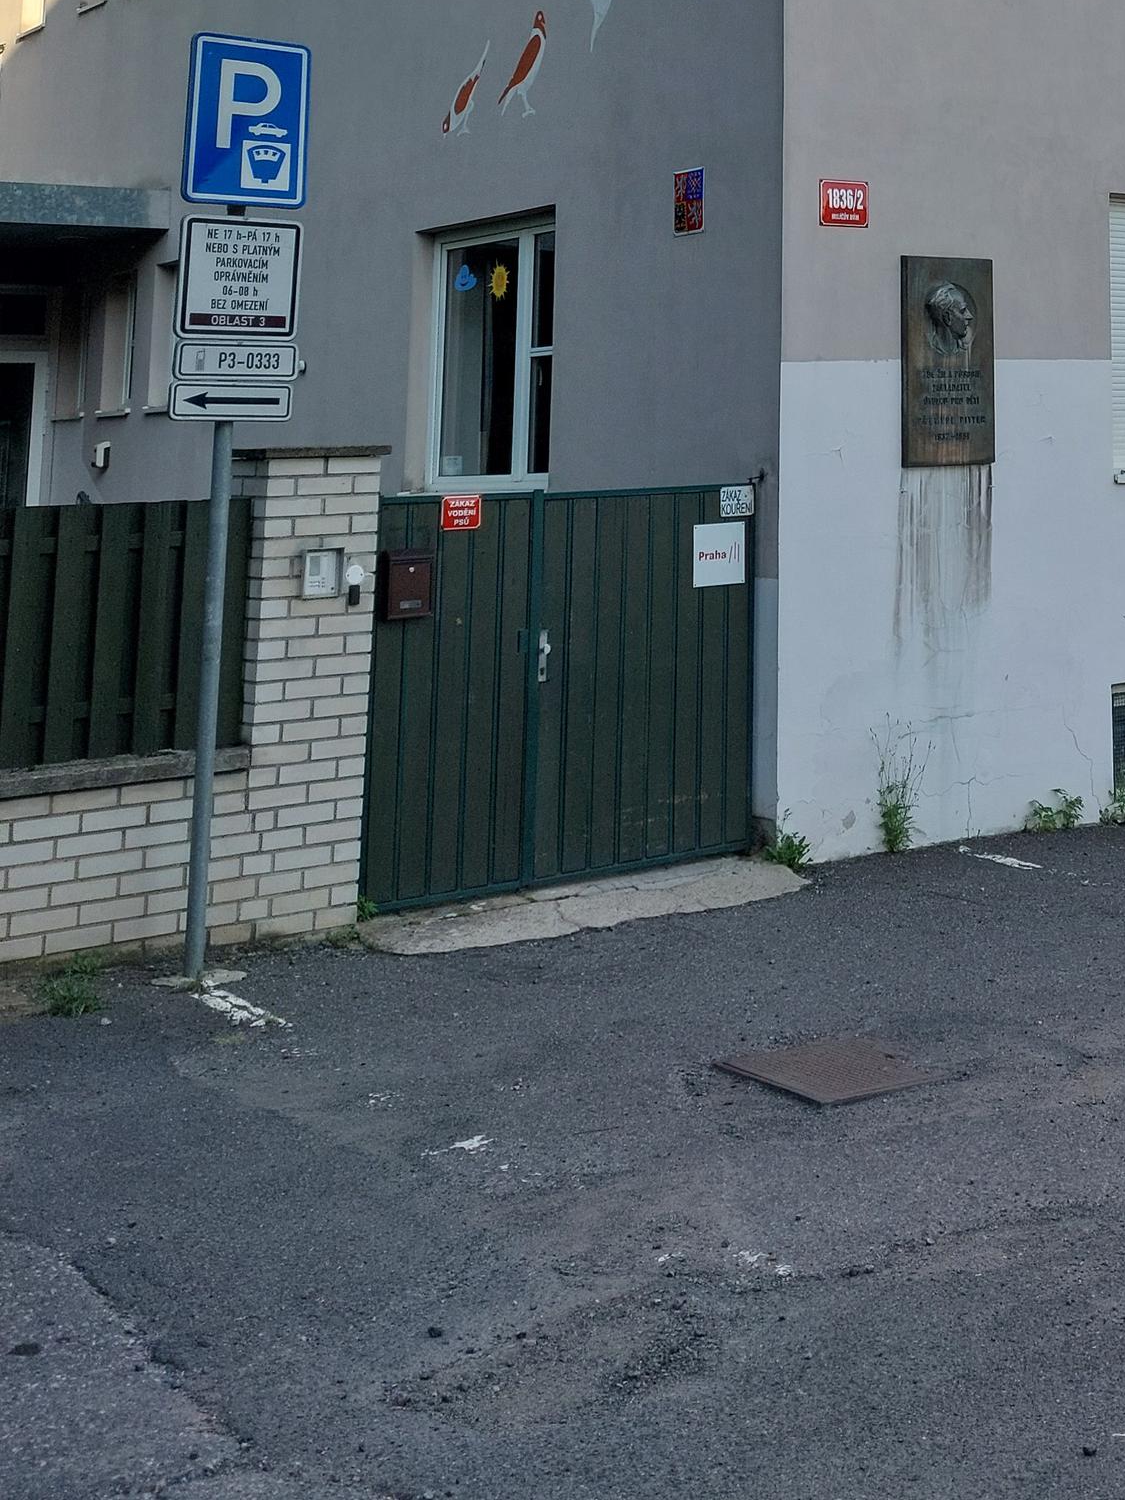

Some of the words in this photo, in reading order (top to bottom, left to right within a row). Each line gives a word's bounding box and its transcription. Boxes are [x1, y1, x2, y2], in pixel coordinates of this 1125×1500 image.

[215, 58, 282, 149] P
[827, 188, 864, 212] 1836/2
[207, 228, 219, 240] NE
[224, 229, 233, 240] 17
[262, 232, 271, 242] 17
[274, 233, 280, 243] h
[205, 242, 229, 253] NEBO
[232, 243, 239, 254] S
[242, 243, 280, 256] PLATNÝM
[215, 256, 269, 270] PARKOVACÍM
[213, 269, 269, 283] OPRÁVNĚNÍM
[222, 285, 249, 297] 06-08
[253, 286, 259, 297] h
[210, 298, 227, 310] BEZ
[230, 298, 270, 311] OMEZENÍ
[211, 315, 255, 326] OBLAST
[259, 316, 266, 327] 3
[218, 351, 280, 370] P3-0333
[721, 488, 742, 503] ZÁKAZ
[449, 499, 475, 508] ZÁKAZ
[447, 507, 477, 517] VODĚNÍ
[453, 516, 470, 526] PSŮ
[698, 549, 727, 562] Praha
